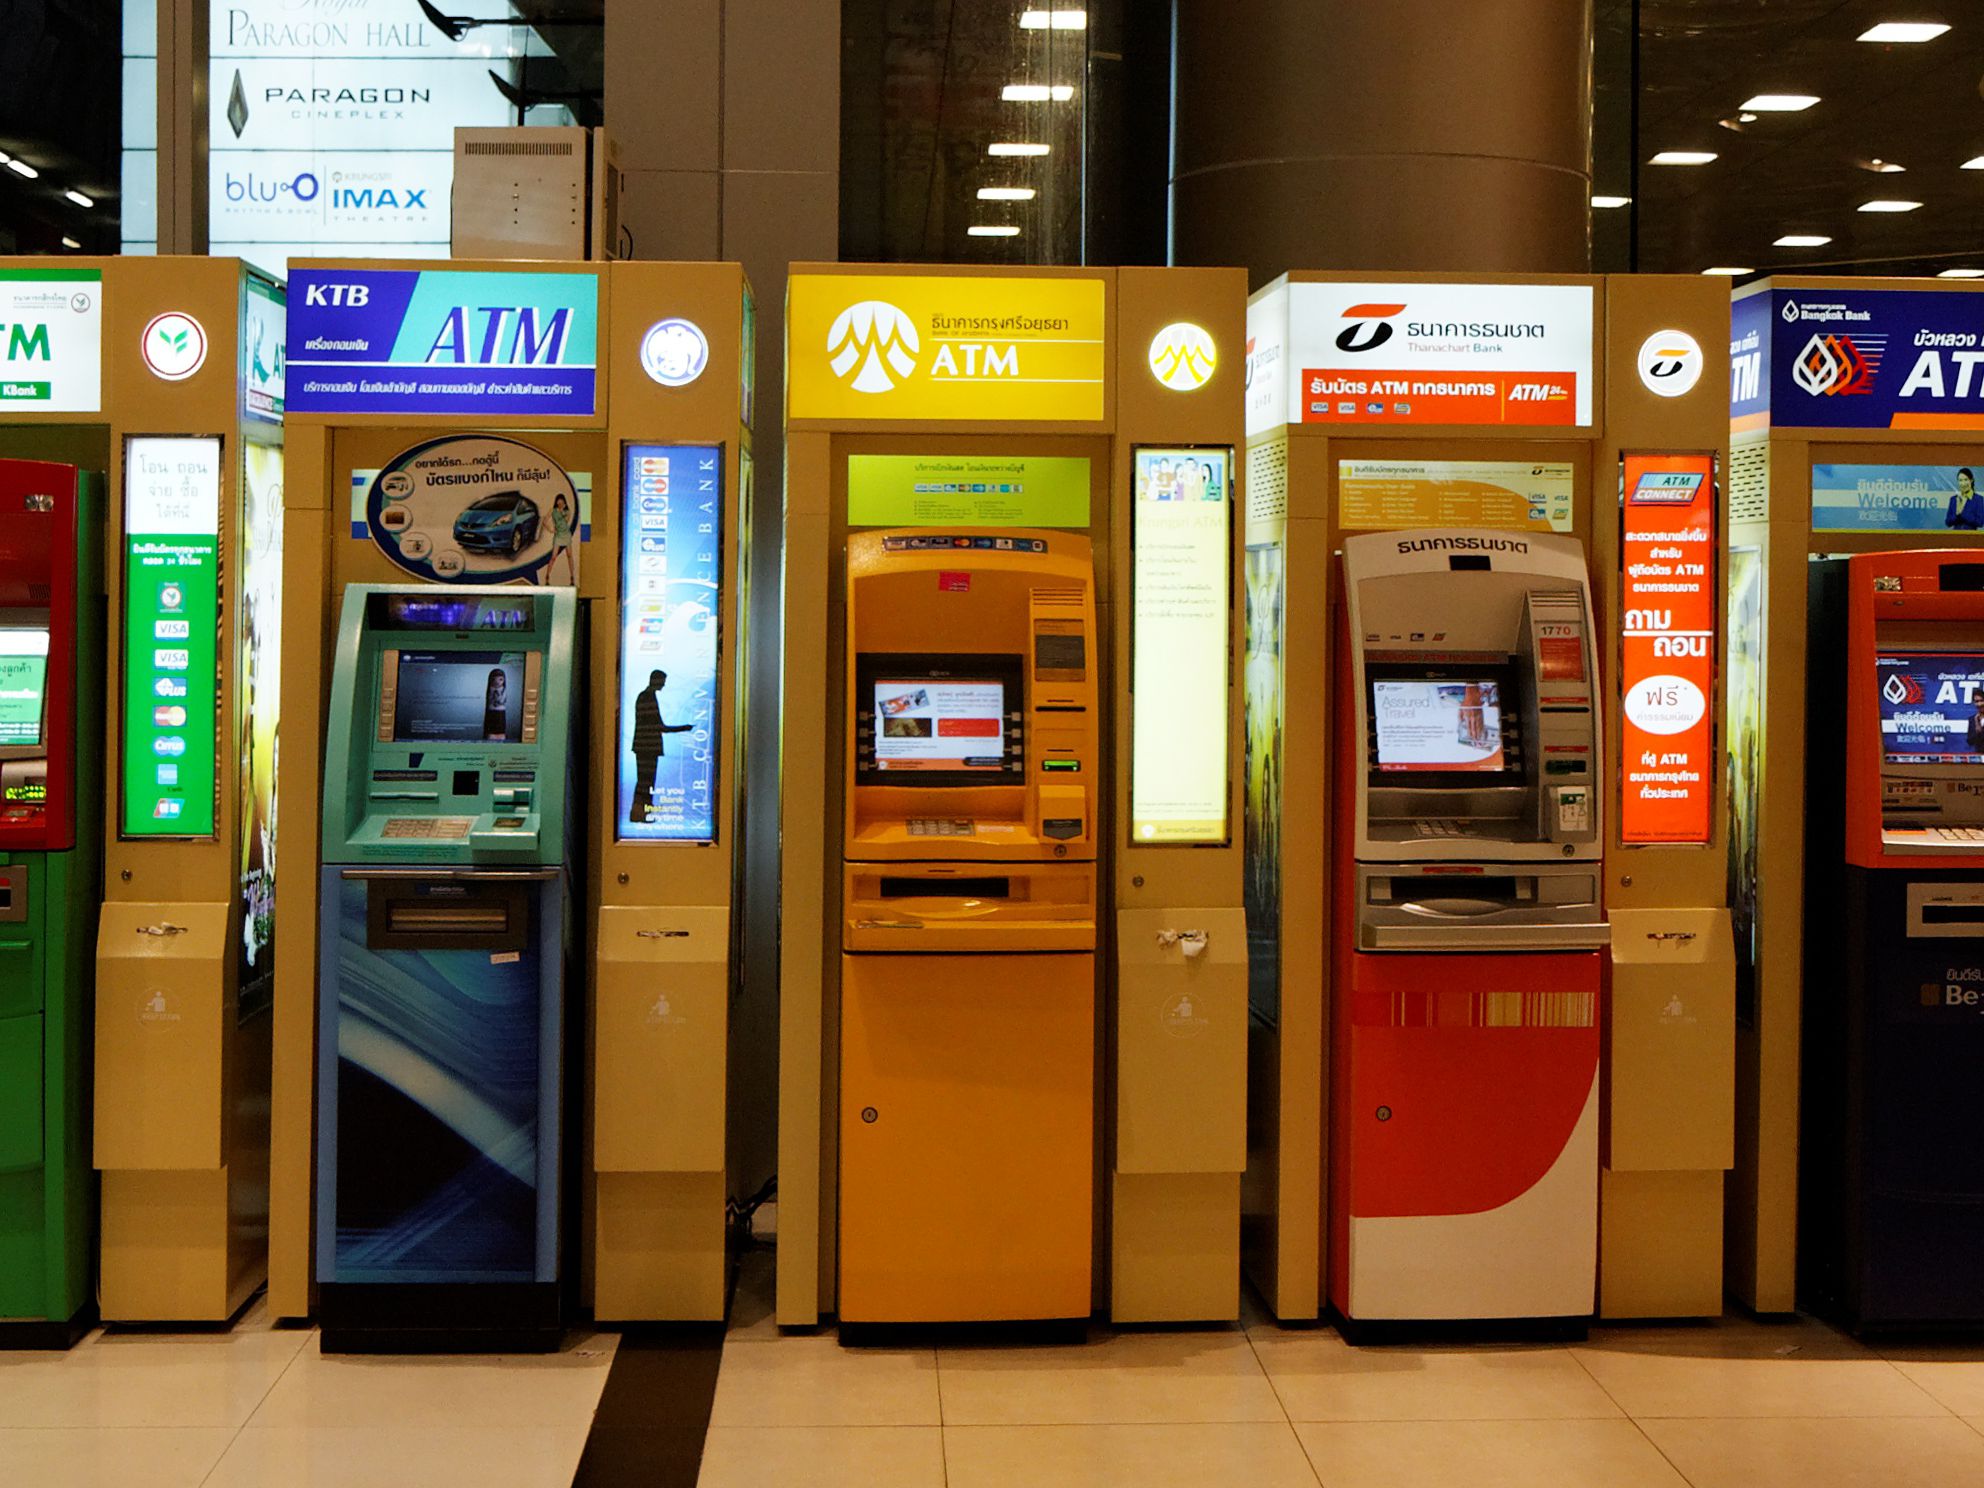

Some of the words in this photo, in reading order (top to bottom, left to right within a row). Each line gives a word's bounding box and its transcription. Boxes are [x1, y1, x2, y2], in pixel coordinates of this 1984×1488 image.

[227, 9, 348, 47] PARAGON
[366, 22, 431, 47] HALL
[265, 88, 430, 103] PARAGON
[292, 110, 404, 119] CINEPLEX
[332, 189, 427, 208] IMAX
[305, 284, 370, 307] KTB
[1801, 310, 1844, 322] Bangkok
[1845, 310, 1871, 321] Bank
[425, 306, 574, 364] ATM
[1407, 321, 1544, 339] ธนาคารธนชาต
[1914, 329, 1974, 347] บัวหลวง
[0, 323, 51, 361] M
[1408, 342, 1470, 353] Thanachart
[1473, 342, 1503, 353] Bank
[930, 344, 1019, 376] ATM
[1898, 350, 1984, 398] AT
[3, 385, 37, 396] KBank
[1311, 377, 1368, 395] รับบัตร
[1370, 381, 1408, 396] ATM
[1508, 384, 1551, 401] ATM
[139, 452, 169, 474] โอน
[177, 461, 208, 474] ถอน
[426, 468, 514, 487] บัตรแบงก์ไหน
[1662, 477, 1691, 486] ATM
[697, 458, 714, 533] BANK
[1636, 489, 1692, 499] CONNECT
[1857, 492, 1938, 509] Welcome
[1397, 536, 1528, 554] ธนาคารธนชาต
[1675, 564, 1704, 575] ATM
[1625, 609, 1671, 629] ถาม
[160, 624, 187, 633] VISA
[1541, 626, 1572, 636] 1770
[1653, 637, 1706, 657] ถอน
[160, 653, 187, 662] VISA
[1381, 696, 1430, 708] Assured
[1646, 685, 1679, 707] ฟรี
[1383, 708, 1416, 719] Travel
[1895, 723, 1952, 734] Welcome
[1660, 754, 1687, 764] ATM
